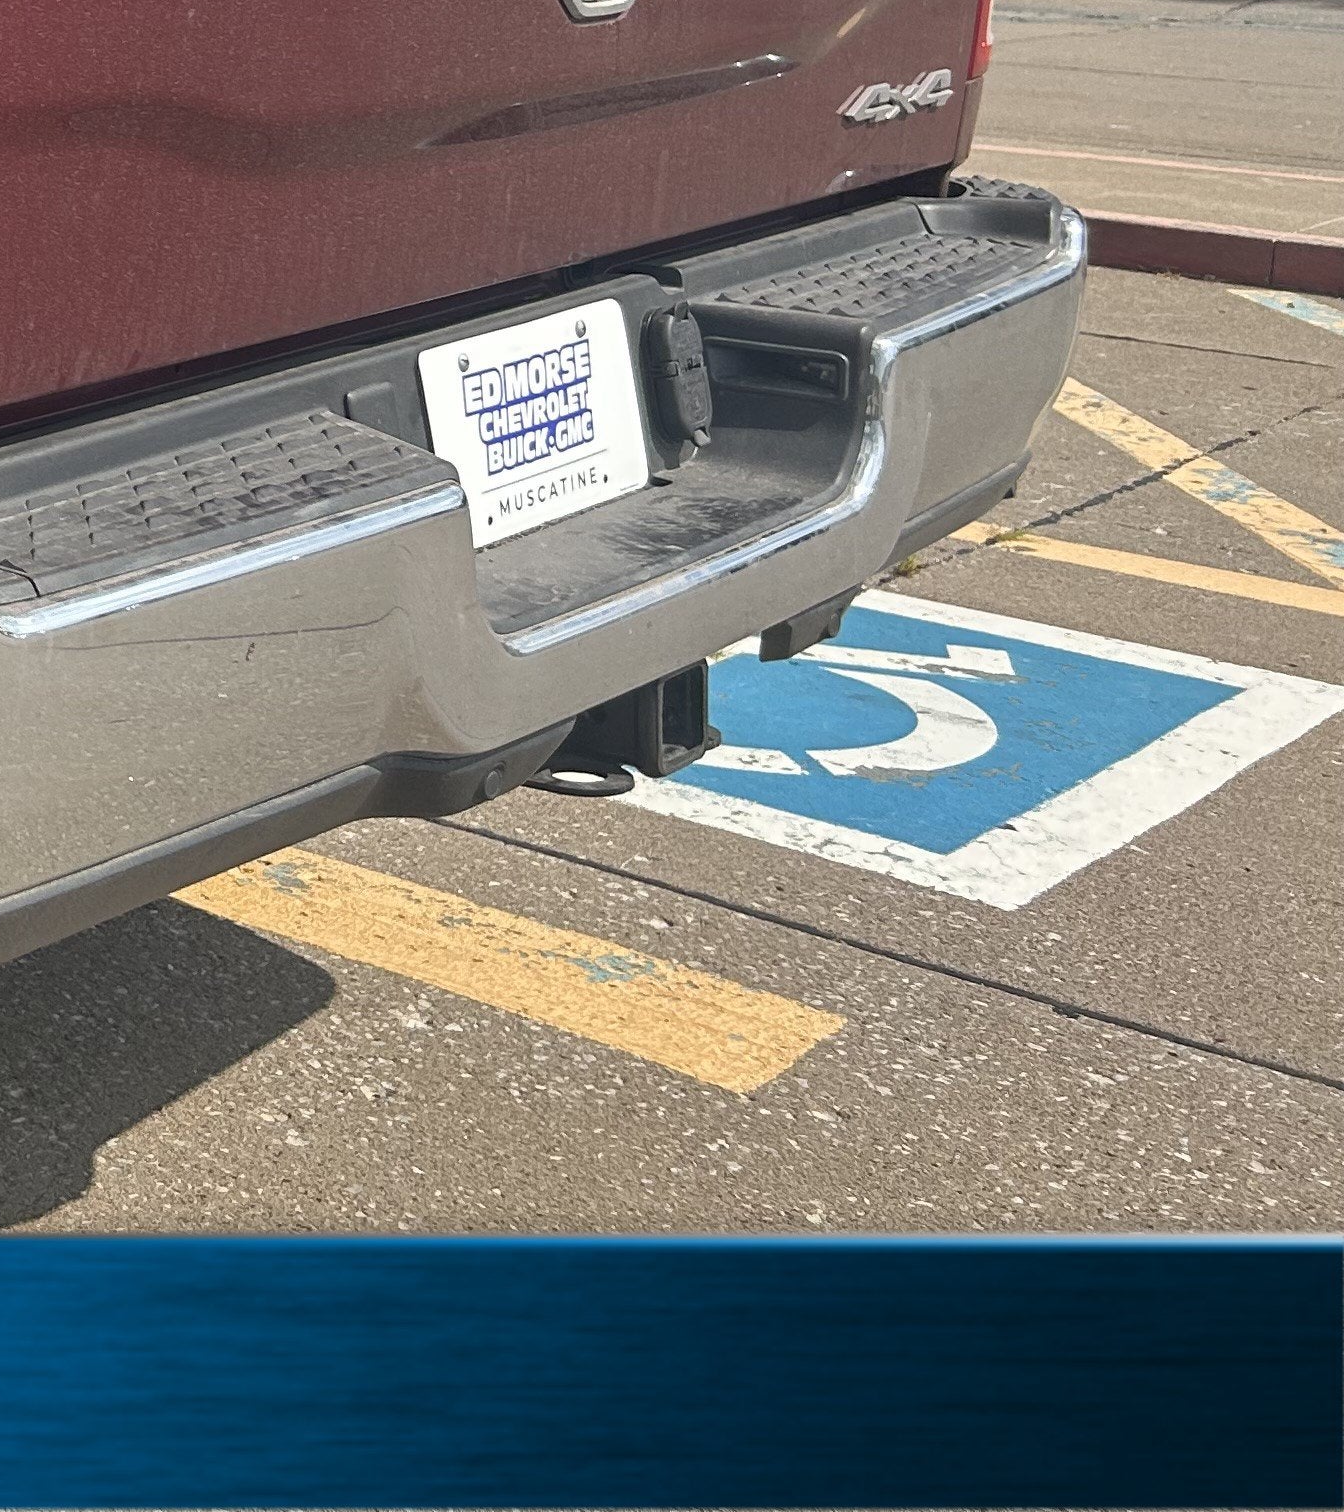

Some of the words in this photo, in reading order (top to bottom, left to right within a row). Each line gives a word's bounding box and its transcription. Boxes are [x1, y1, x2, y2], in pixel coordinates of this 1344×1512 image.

[462, 367, 504, 416] ED
[503, 339, 592, 405] MORSE
[479, 379, 591, 444] CHEVROLET
[498, 466, 599, 517] MUSCATINE
